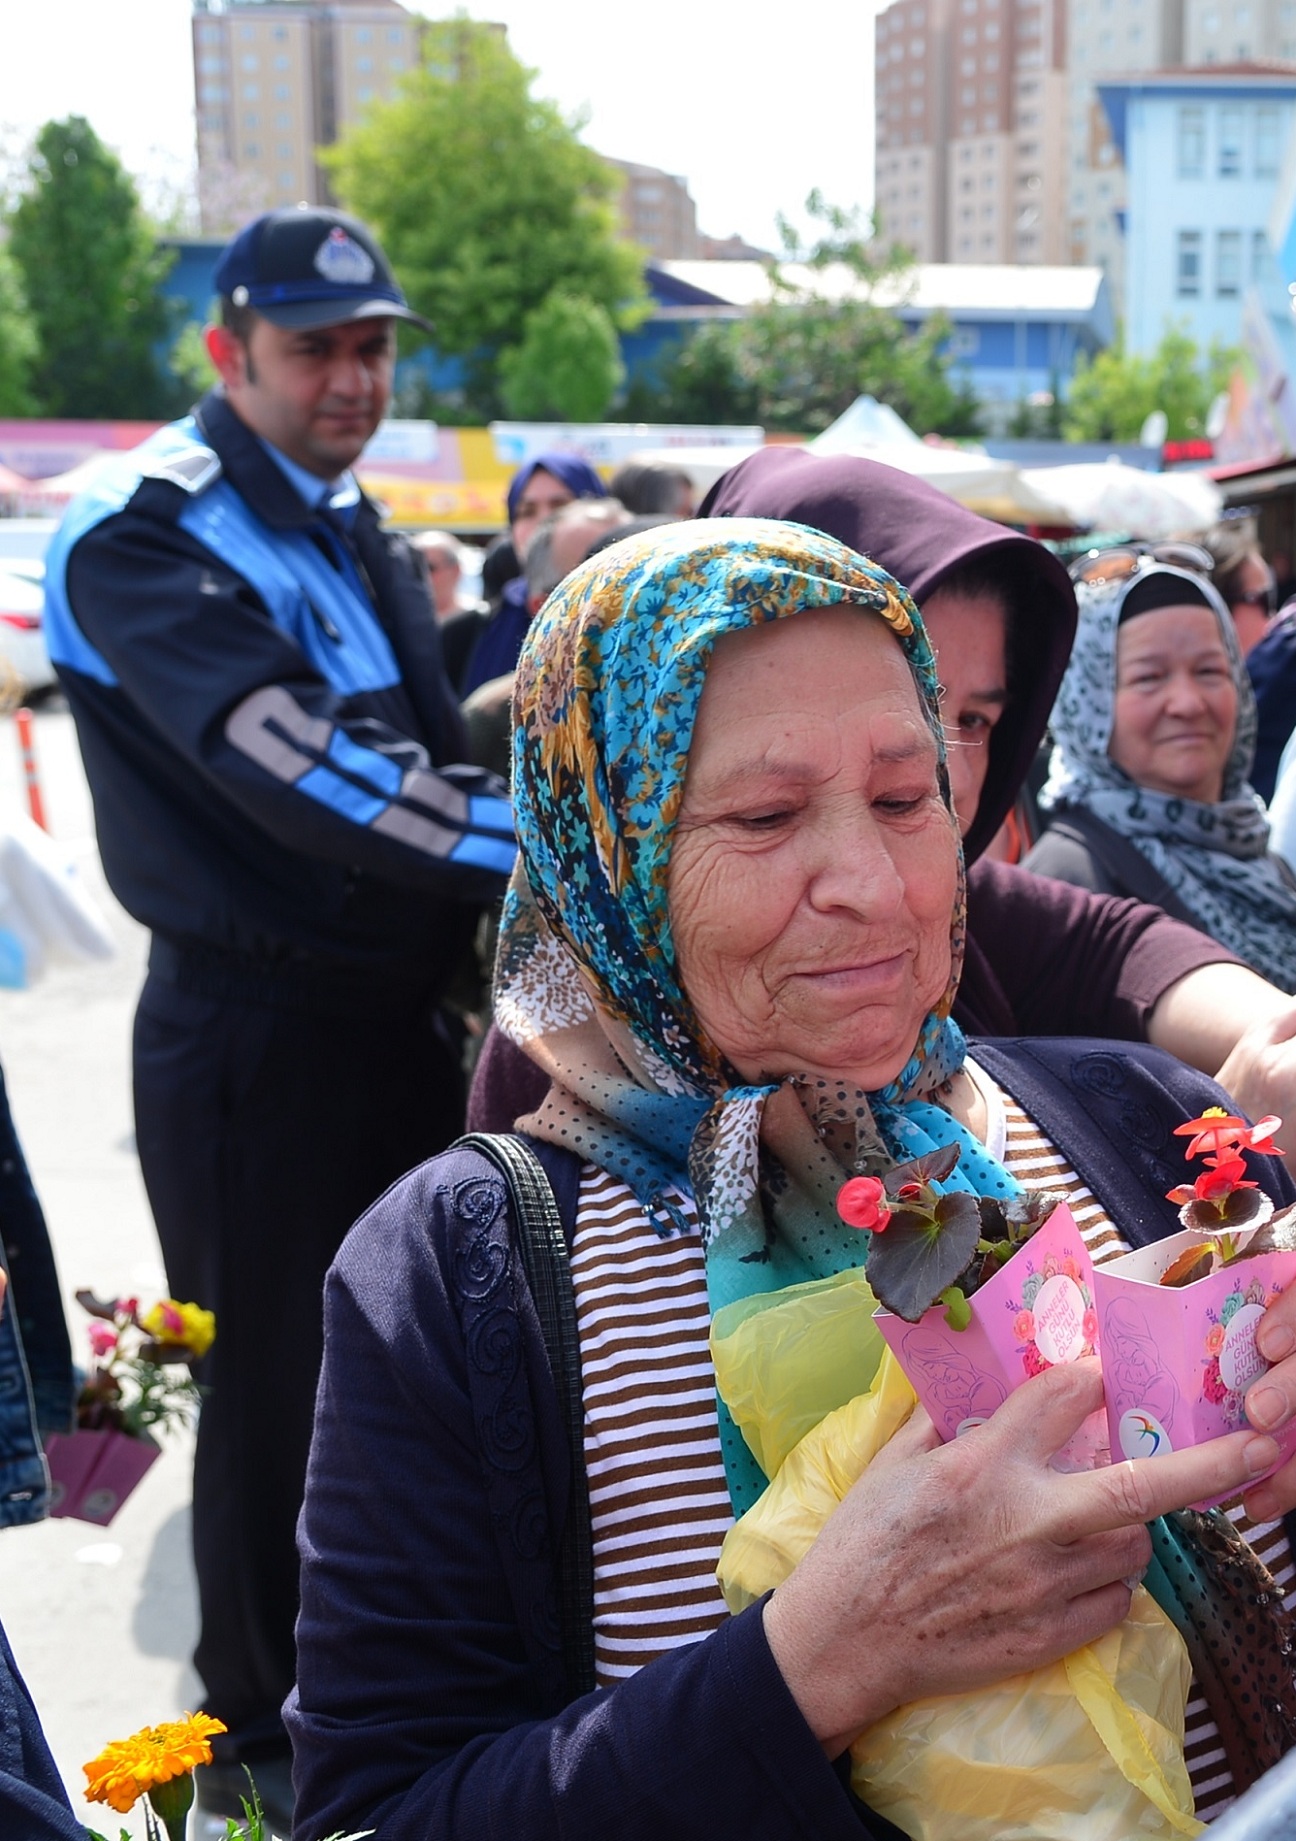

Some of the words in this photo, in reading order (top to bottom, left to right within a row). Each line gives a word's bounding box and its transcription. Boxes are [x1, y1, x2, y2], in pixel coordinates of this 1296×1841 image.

[1038, 1280, 1069, 1332] ANNELER
[1049, 1299, 1069, 1334] GÜNÜ
[1053, 1308, 1075, 1347] KUTLU
[1058, 1319, 1080, 1358] OLSUN
[1234, 1337, 1255, 1360] GÜN
[1234, 1350, 1259, 1374] KUTL
[1235, 1360, 1267, 1387] OLSUN
